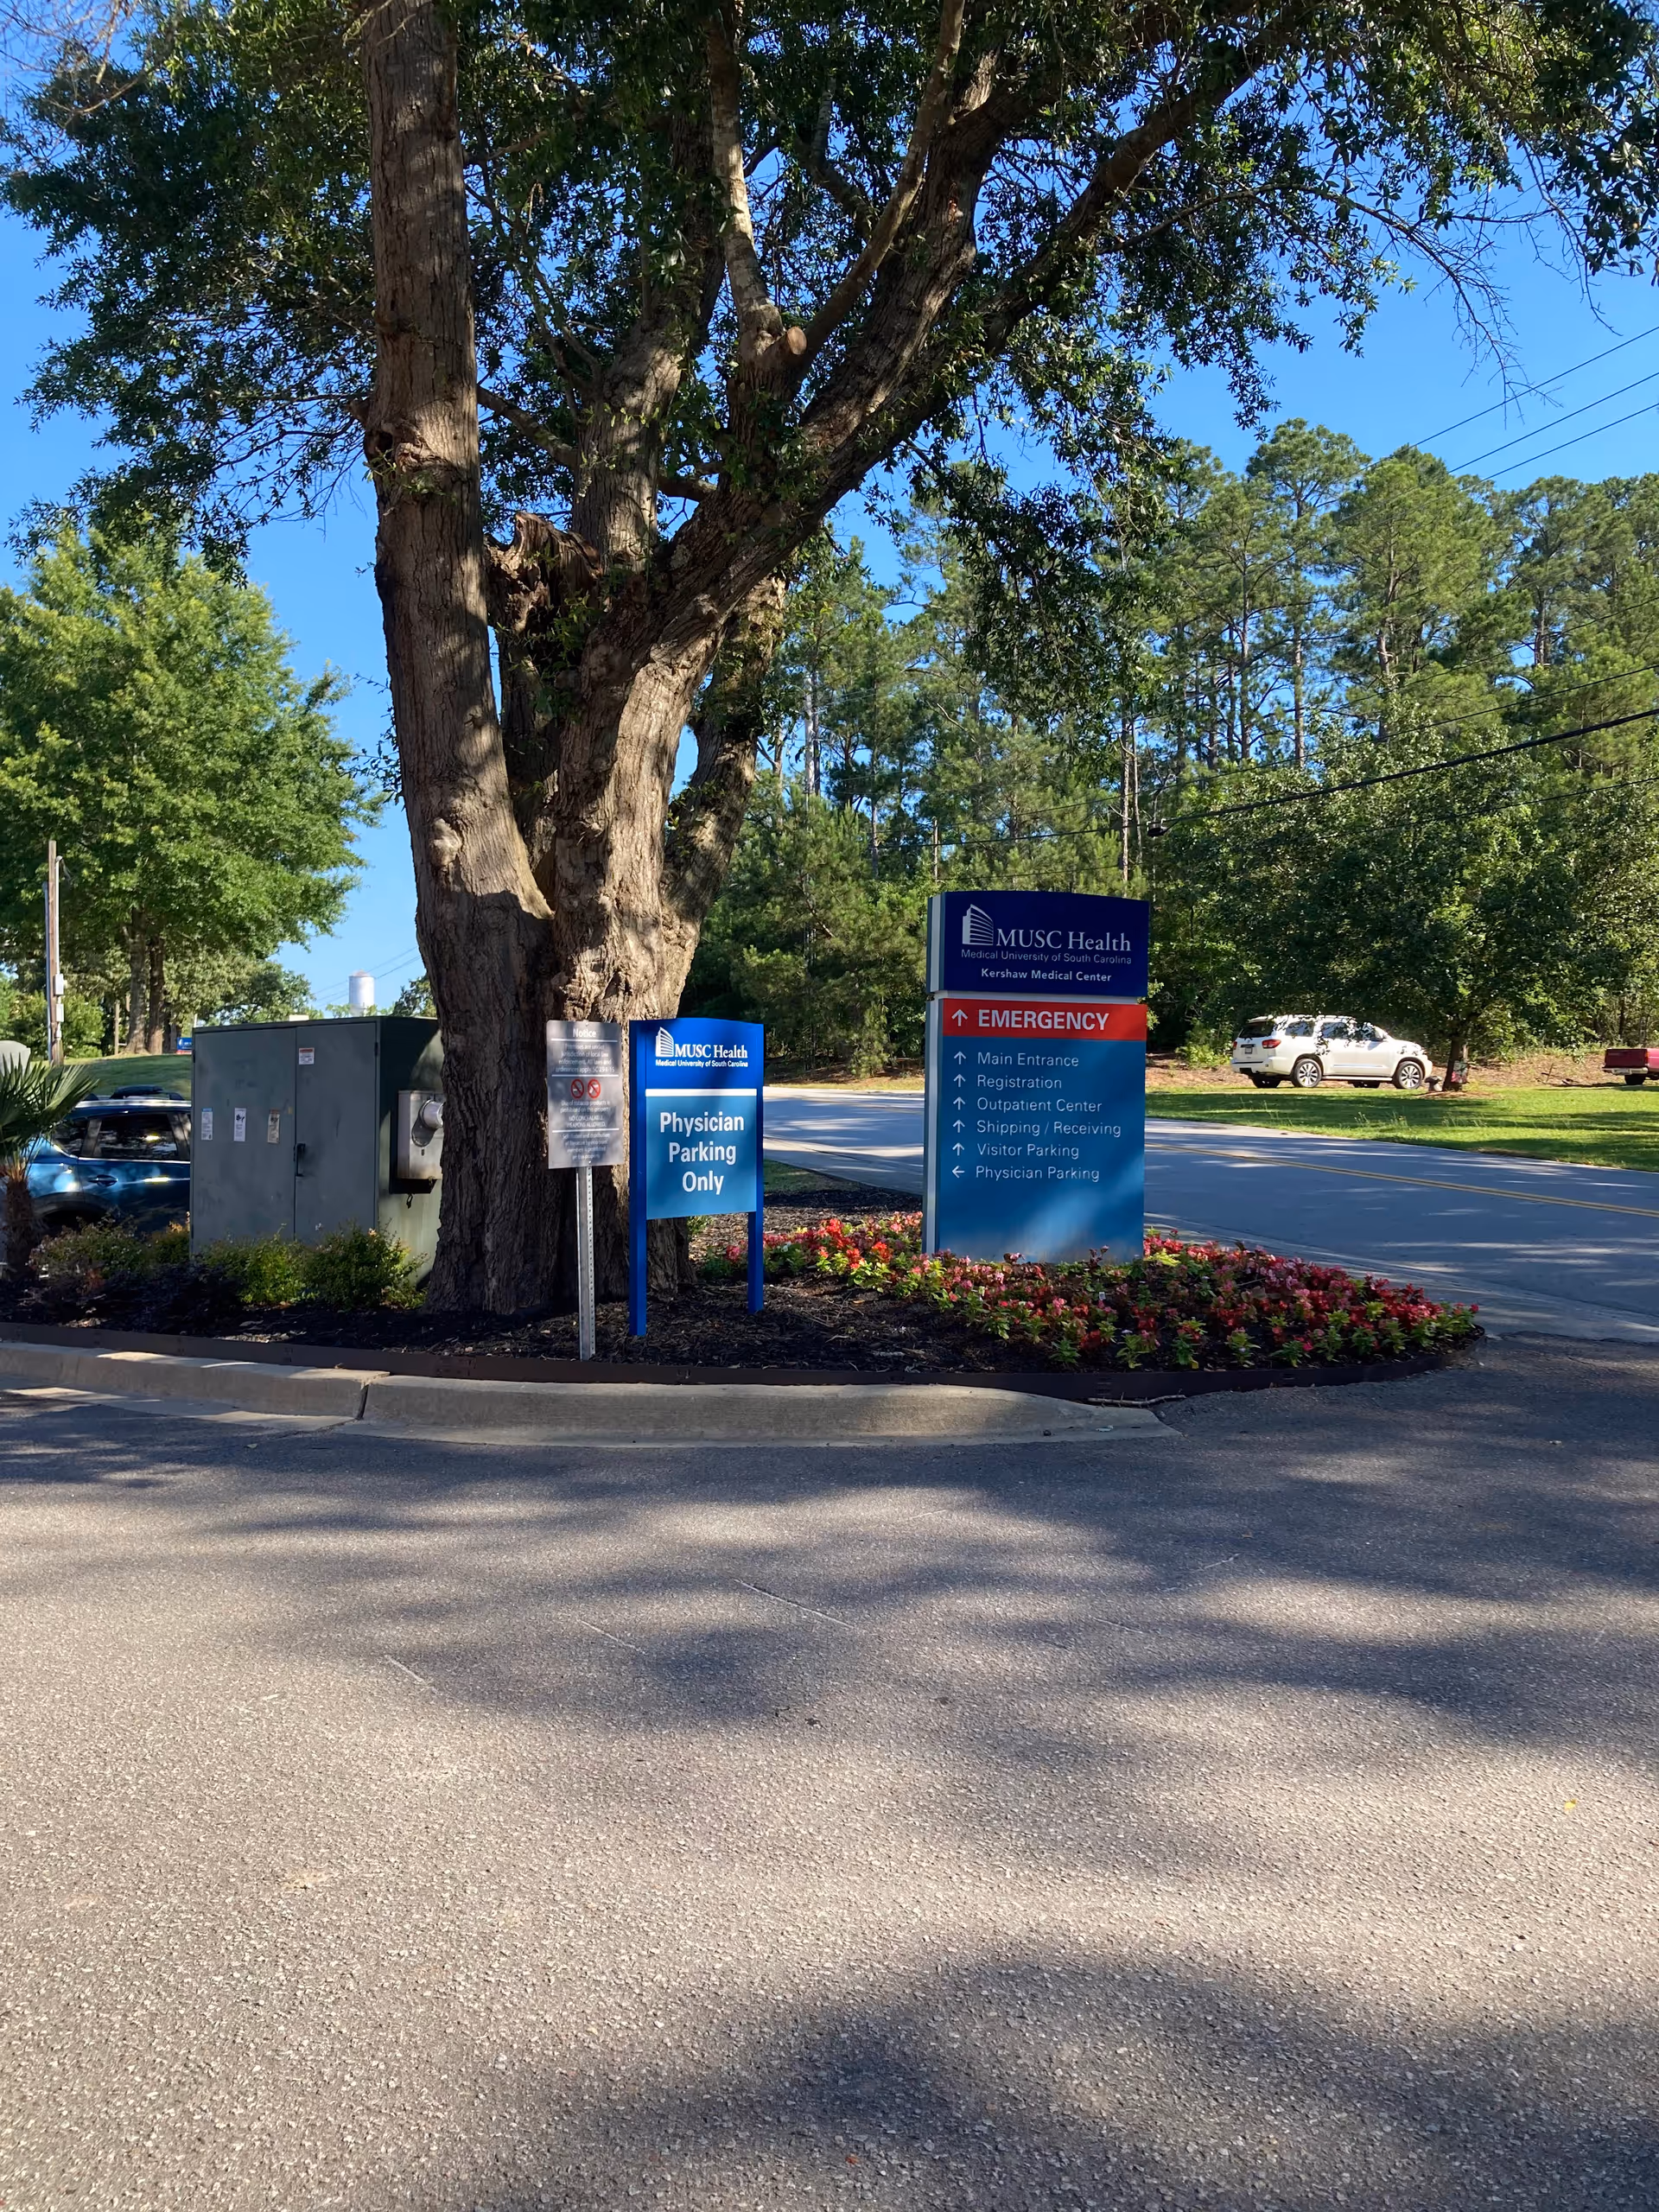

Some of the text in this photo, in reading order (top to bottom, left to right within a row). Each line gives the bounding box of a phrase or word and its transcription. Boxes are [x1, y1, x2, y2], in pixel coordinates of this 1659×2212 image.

[995, 928, 1132, 951] MUSC Health
[961, 949, 1132, 964] Medical University of South Carolina
[982, 968, 1112, 982] Kershaw Medical Center
[978, 1009, 1109, 1031] EMERGENCY
[572, 1028, 596, 1038] Notice
[675, 1044, 748, 1058] MUSC Health
[677, 1059, 704, 1068] University
[977, 1052, 1079, 1067] Main Entrance
[977, 1075, 1062, 1090] Registration
[976, 1097, 1103, 1113] Outpatient Center
[660, 1111, 745, 1137] Physician
[976, 1120, 1122, 1138] Shipping / Receiving
[669, 1141, 736, 1166] Parking
[977, 1143, 1079, 1160] Visitor Parking
[976, 1166, 1100, 1182] Physician Parking
[682, 1170, 724, 1196] Only
